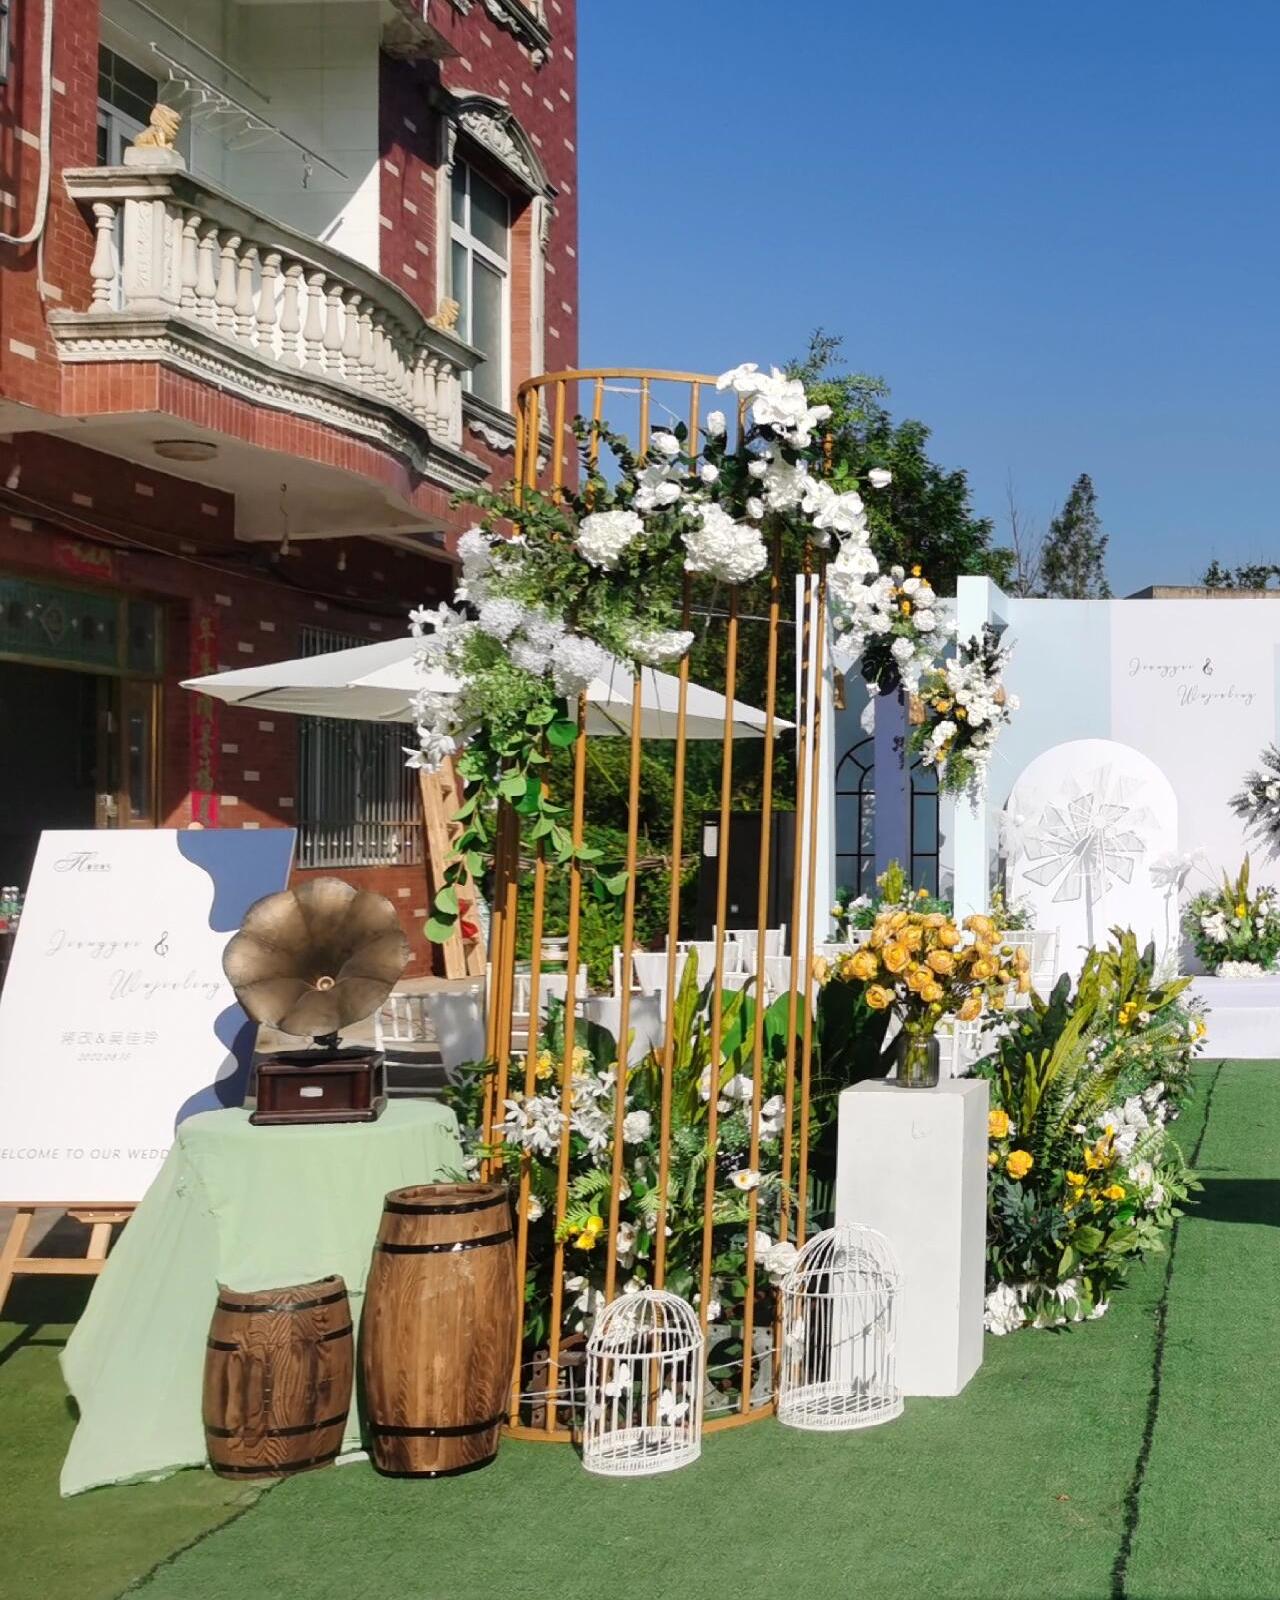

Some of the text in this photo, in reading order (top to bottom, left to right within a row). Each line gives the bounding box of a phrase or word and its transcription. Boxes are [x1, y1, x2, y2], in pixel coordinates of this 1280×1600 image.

[154, 930, 170, 957] &
[0, 1147, 170, 1160] ELCOME TO OUR WEDD
